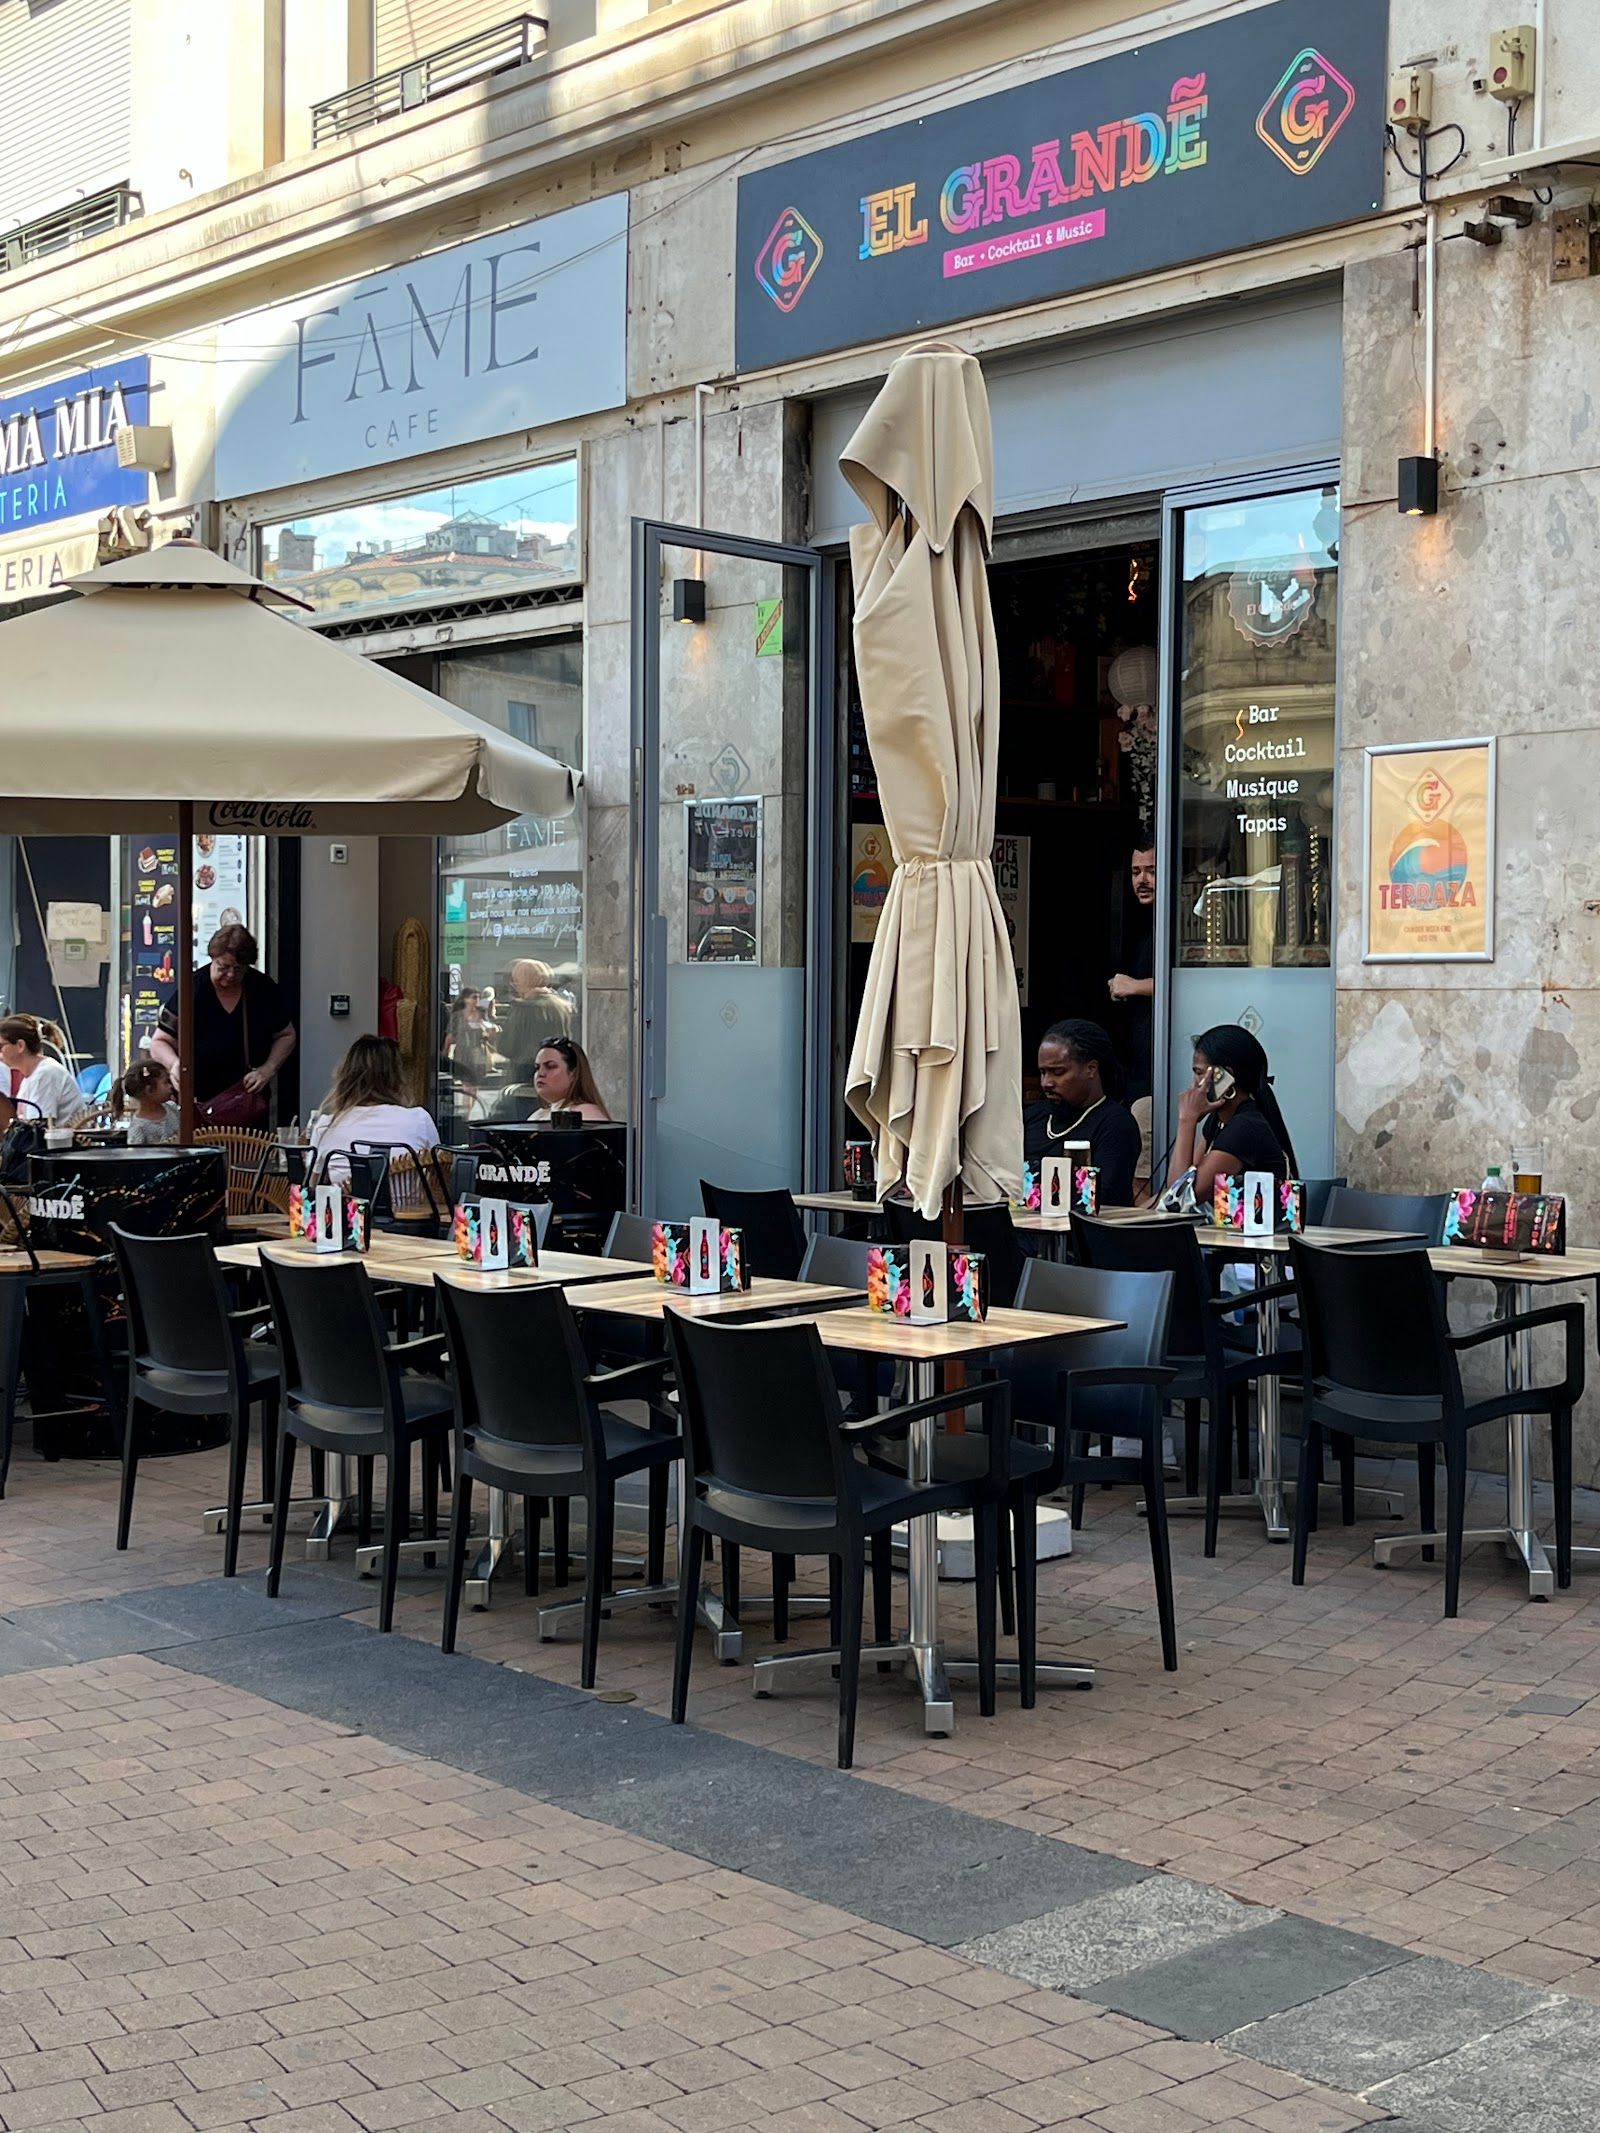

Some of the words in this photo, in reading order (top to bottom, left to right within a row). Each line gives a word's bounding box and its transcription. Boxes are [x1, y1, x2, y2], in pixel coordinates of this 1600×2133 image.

[858, 182, 929, 261] EL
[953, 254, 975, 270] Bar
[987, 233, 1043, 261] Cocktail
[1045, 229, 1054, 246] &
[1056, 220, 1093, 243] Music
[53, 379, 130, 459] MIA
[364, 408, 439, 449] CAFE
[0, 551, 64, 592] ERIA
[1248, 704, 1280, 725] Bar
[1224, 737, 1307, 764] Cocktail
[1226, 776, 1300, 800] Musique
[1236, 813, 1288, 838] Tapas
[1379, 881, 1477, 910] TERRAZA
